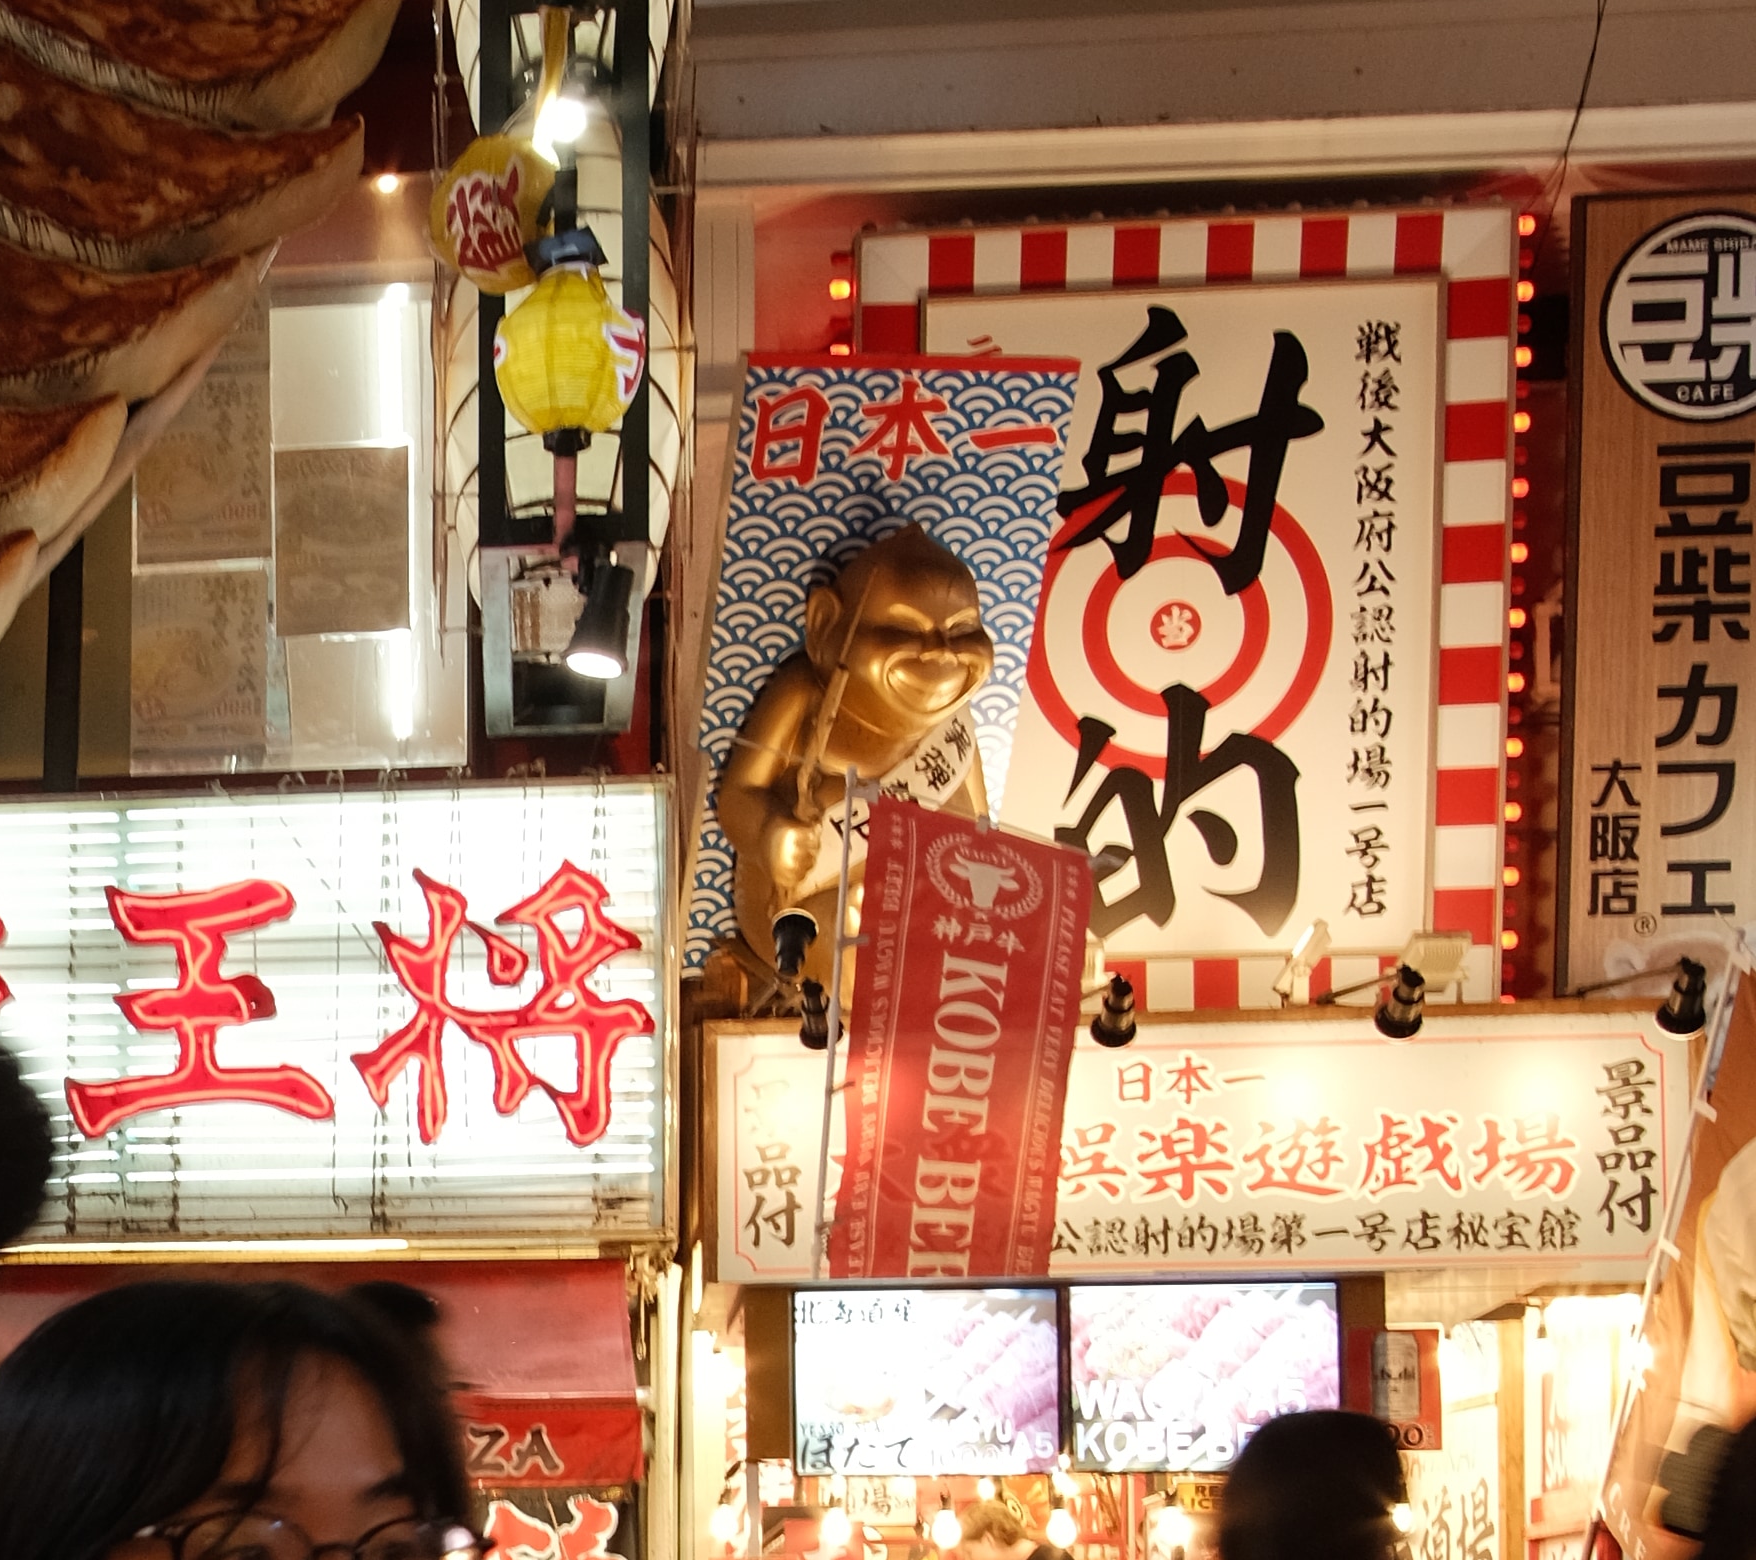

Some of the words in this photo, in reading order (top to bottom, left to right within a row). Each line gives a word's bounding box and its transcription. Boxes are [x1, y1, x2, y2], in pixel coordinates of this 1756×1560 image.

[1666, 238, 1709, 254] MAME
[749, 376, 1059, 488] 日本一
[1676, 384, 1735, 403] CAFE
[1056, 306, 1326, 940] 射的
[1344, 319, 1401, 918] 戦後大阪府公認射的場一号店
[1653, 442, 1755, 915] 豆柴カフェ
[1588, 759, 1641, 917] 大阪店
[932, 914, 1026, 956] 神戸牛
[922, 950, 1009, 1136] KOBE
[1116, 1056, 1267, 1105] 日本一
[1595, 1057, 1659, 1235] 景品付
[799, 1437, 915, 1473] ほたて
[1077, 1421, 1195, 1462] KOBE
